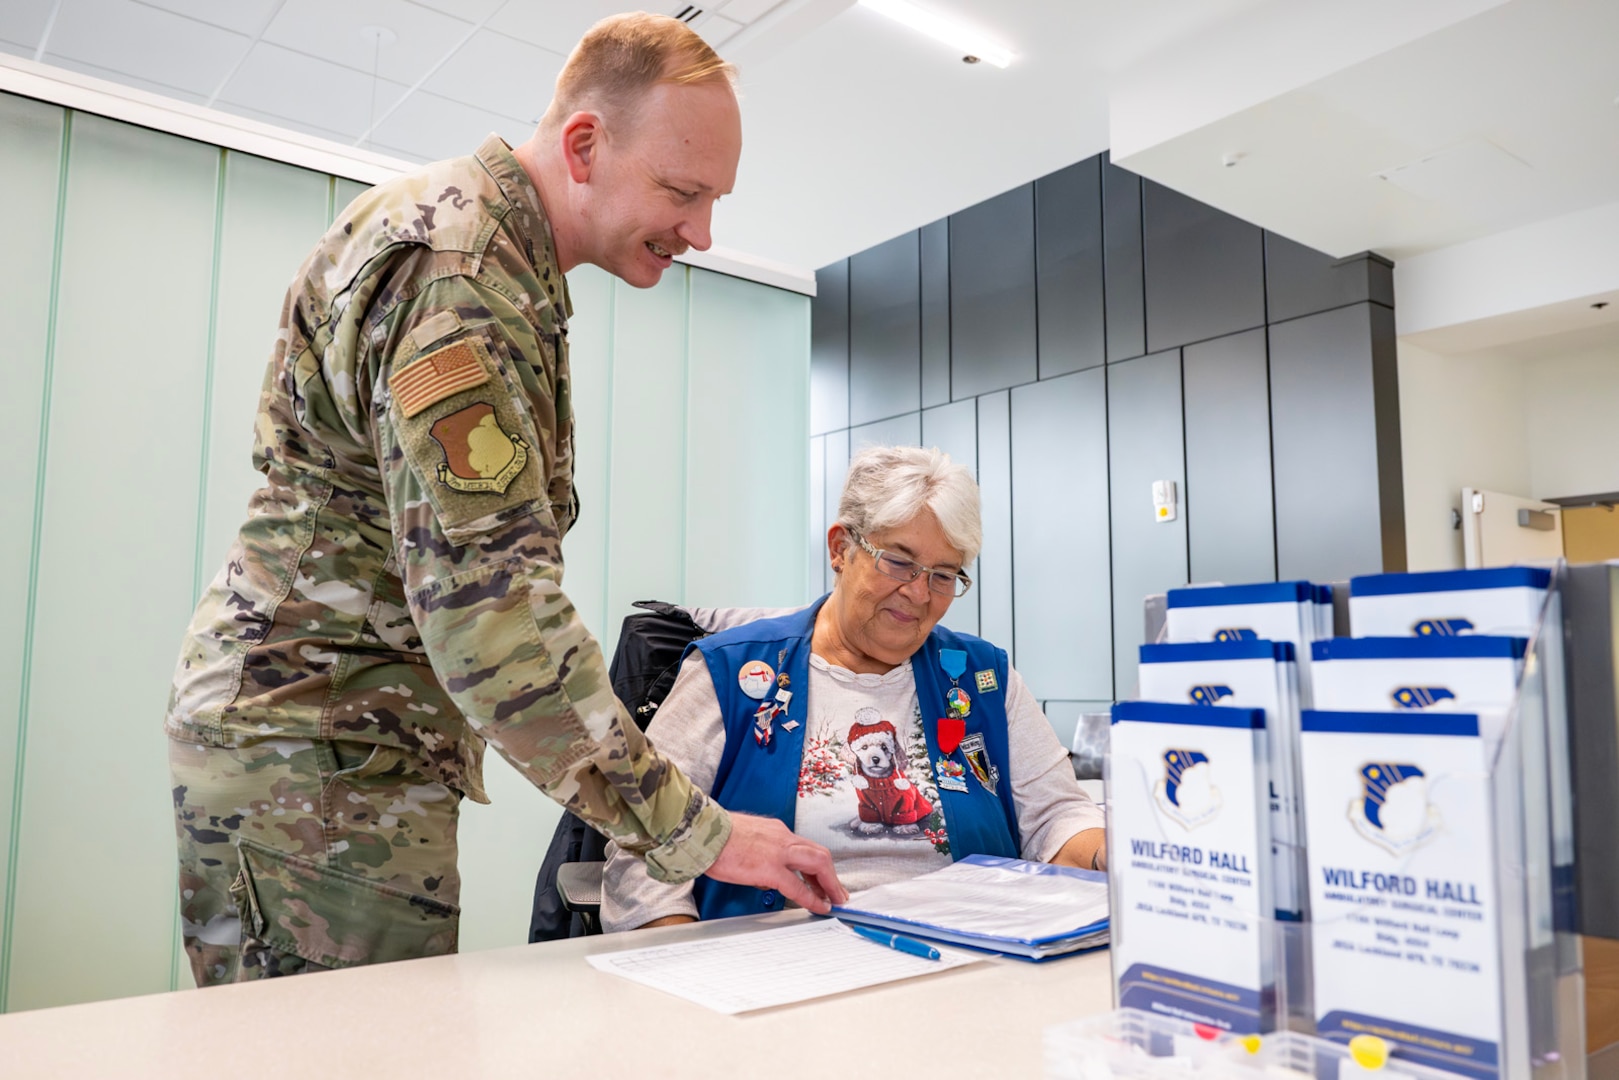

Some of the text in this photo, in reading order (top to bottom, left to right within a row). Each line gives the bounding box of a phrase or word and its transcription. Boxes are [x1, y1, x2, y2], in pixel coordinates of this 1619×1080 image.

[1131, 838, 1251, 874] WILFORD HALL
[1322, 866, 1482, 905] WILFORD HALL
